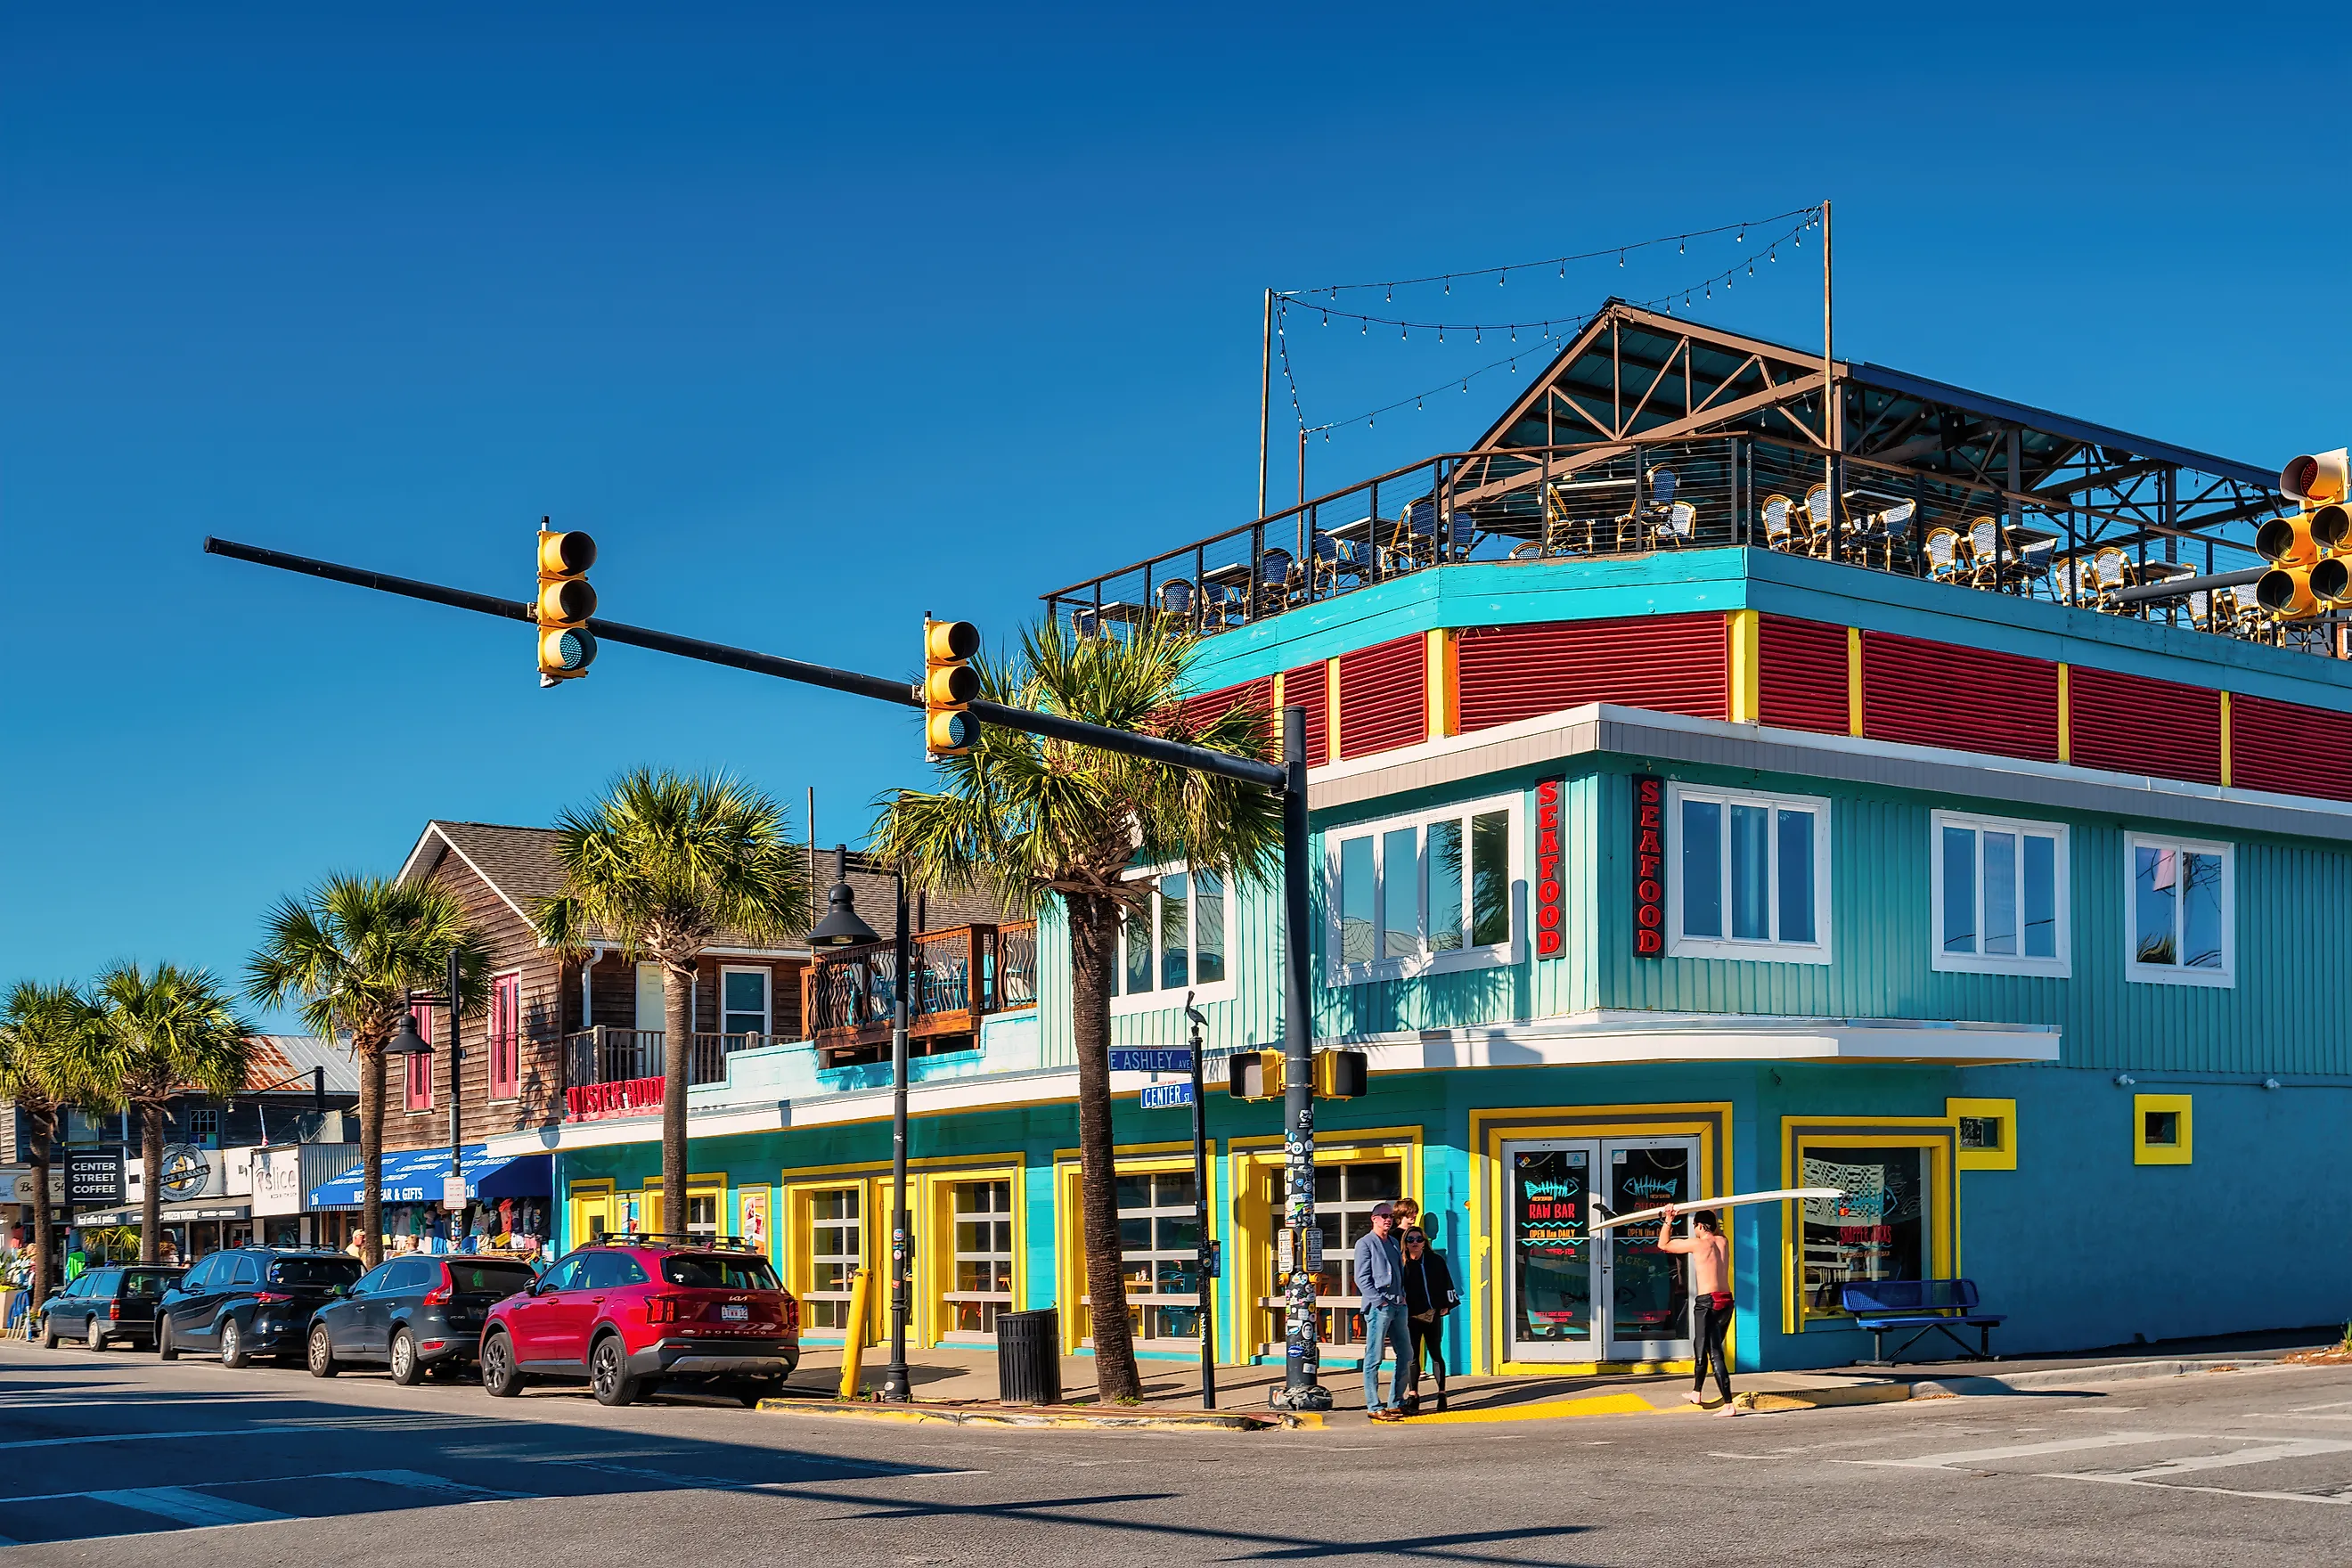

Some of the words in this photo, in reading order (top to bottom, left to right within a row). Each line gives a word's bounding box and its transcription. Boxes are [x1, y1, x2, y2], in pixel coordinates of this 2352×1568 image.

[1539, 780, 1560, 955] SEAFOOD
[1638, 780, 1662, 953] SEAFOOD
[1110, 1052, 1118, 1069] E
[1123, 1051, 1173, 1069] ASHLEY
[1179, 1059, 1191, 1069] AVE
[625, 1075, 666, 1109] ROO
[1145, 1085, 1180, 1107] CENTER
[1184, 1093, 1190, 1102] ST
[71, 1162, 117, 1172] CENTER
[72, 1173, 117, 1182] STREET
[72, 1185, 117, 1194] COFFEE
[395, 1188, 401, 1201] &
[402, 1187, 423, 1200] GIFTS
[466, 1184, 476, 1198] 16
[310, 1193, 319, 1205] 16
[1529, 1204, 1551, 1219] RAW
[1554, 1203, 1575, 1219] BAR
[1529, 1229, 1546, 1238] OPEN
[1558, 1229, 1575, 1238] DAILY
[1628, 1229, 1643, 1237] OPEN
[1616, 1254, 1650, 1269] ACKS
